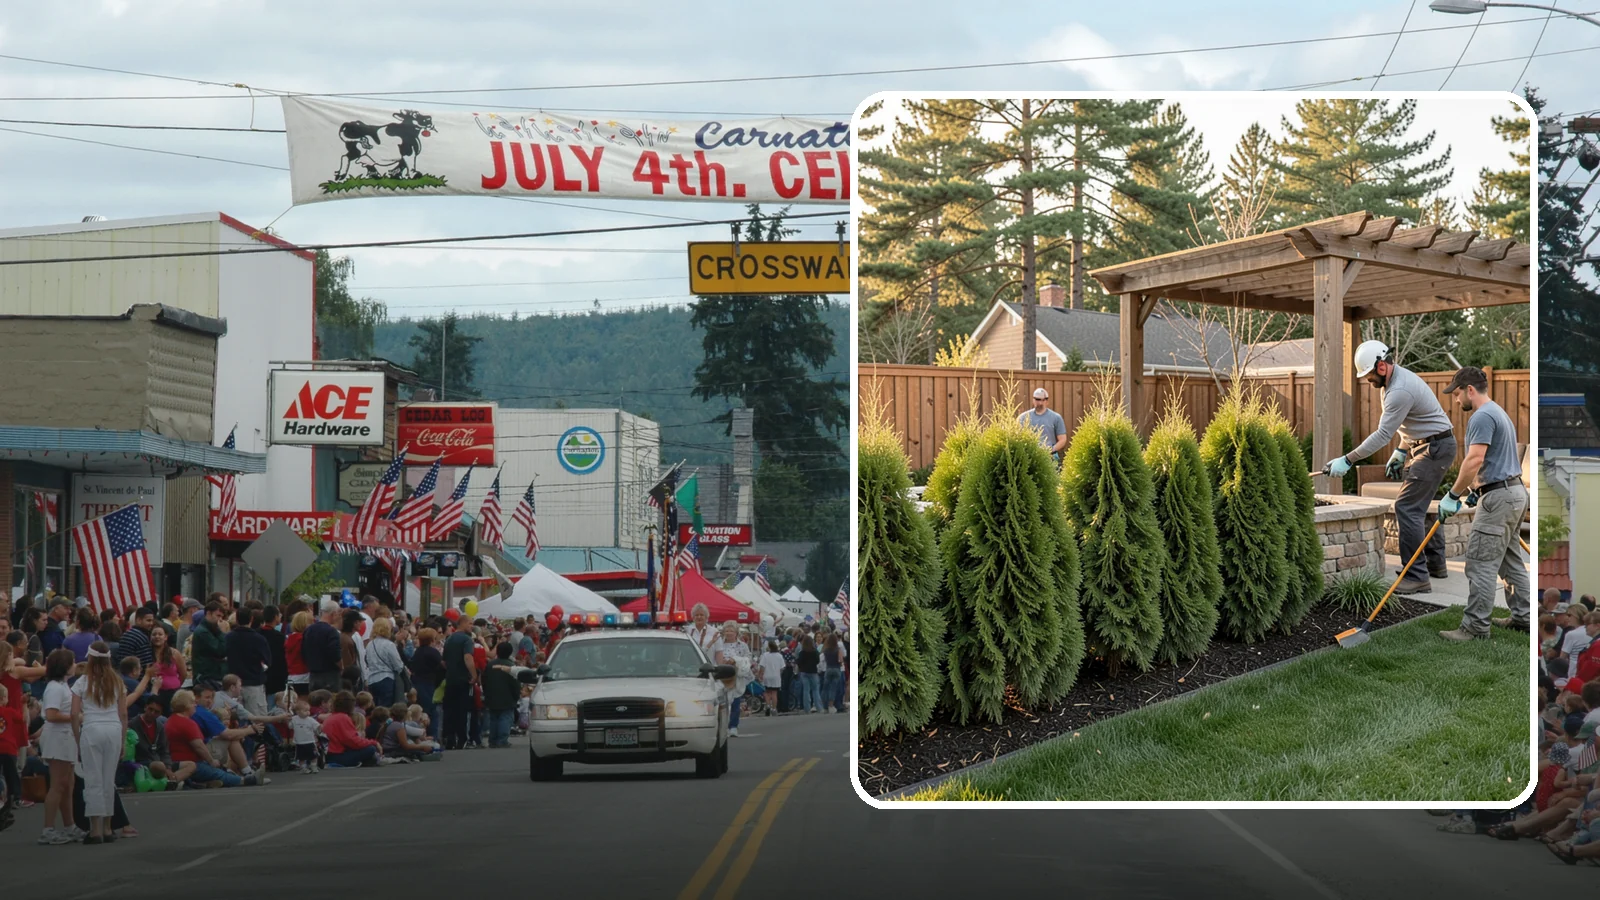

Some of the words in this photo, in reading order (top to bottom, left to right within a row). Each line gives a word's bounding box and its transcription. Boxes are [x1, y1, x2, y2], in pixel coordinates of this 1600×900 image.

[481, 141, 605, 193] JULY
[632, 149, 746, 198] 4th.
[697, 254, 850, 280] CROSSWA
[282, 380, 374, 420] ACE
[405, 409, 452, 422] CEDAR
[283, 421, 371, 437] Hardware
[416, 428, 476, 447] Coca-Cola
[353, 466, 385, 479] Simpl
[96, 485, 124, 495] Vincent
[126, 486, 135, 495] de
[137, 486, 155, 496] Paul
[688, 526, 741, 535] CRNATION
[699, 535, 730, 543] GLASS
